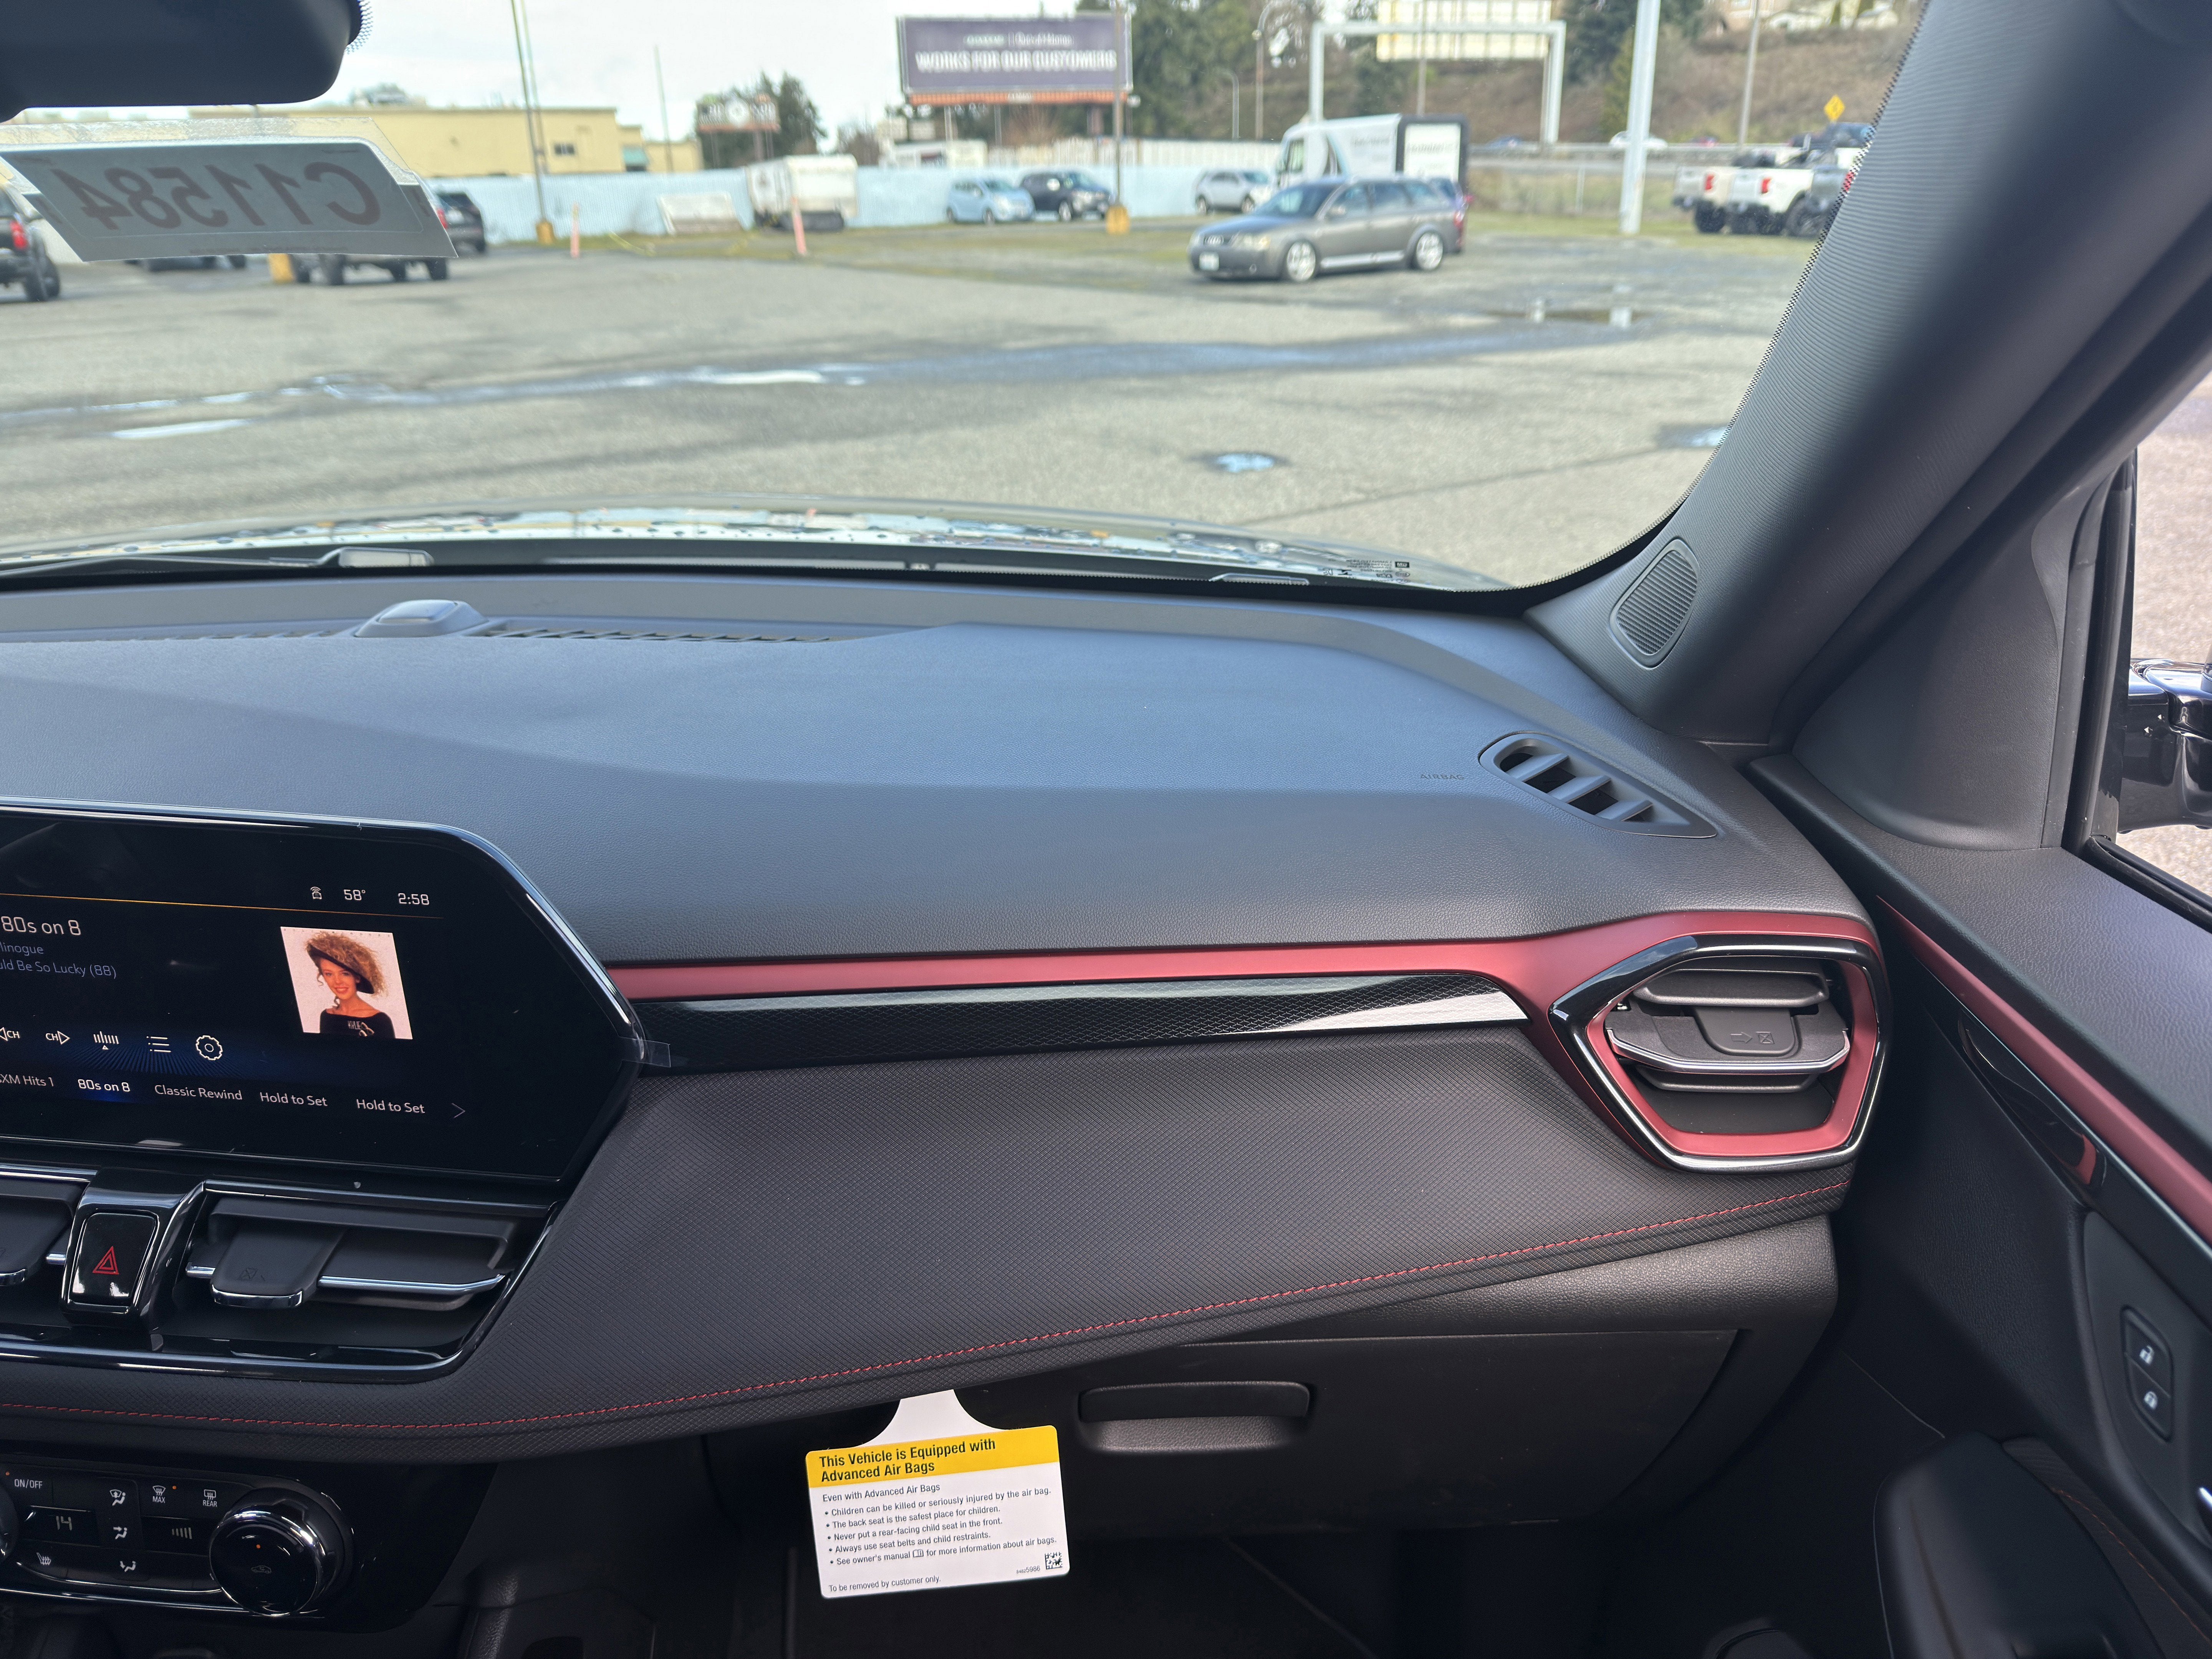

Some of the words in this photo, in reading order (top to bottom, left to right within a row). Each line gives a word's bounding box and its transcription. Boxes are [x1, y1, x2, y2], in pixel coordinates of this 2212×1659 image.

[344, 889, 365, 900] 58°
[398, 893, 429, 905] 2:58
[1, 916, 36, 932] 80s
[42, 923, 64, 934] on
[68, 920, 81, 935] 8
[0, 942, 43, 956] inogue
[17, 960, 32, 970] Be
[35, 962, 50, 972] So
[53, 963, 85, 977] Lucky
[90, 965, 116, 979] (88)
[23, 1076, 46, 1086] Hits
[48, 1078, 53, 1086] 1
[78, 1079, 101, 1089] 80s
[122, 1082, 130, 1091] 8
[155, 1085, 196, 1096] Classic
[199, 1088, 242, 1099] Rewind
[260, 1092, 288, 1103] Hold
[291, 1095, 304, 1104] to
[307, 1096, 327, 1106] Set
[357, 1099, 385, 1110] Hold
[389, 1103, 401, 1111] to
[404, 1103, 425, 1113] Set
[819, 1456, 845, 1467] This
[848, 1451, 892, 1464] Vehicle
[896, 1450, 906, 1460] is
[911, 1442, 965, 1458] Equipped
[970, 1440, 995, 1451] with
[821, 1467, 880, 1482] Advanced
[884, 1465, 901, 1476] Air
[905, 1462, 935, 1474] Bags
[15, 1479, 42, 1488] ON/OFF
[845, 1491, 862, 1500] with
[865, 1487, 904, 1498] Advanced
[907, 1485, 917, 1493] Air
[921, 1485, 940, 1493] Bags
[832, 1508, 864, 1516] Children
[895, 1501, 916, 1510] killed
[929, 1497, 963, 1506] seriously
[966, 1493, 993, 1503] injured
[909, 1512, 932, 1521] safest
[934, 1511, 954, 1520] place
[969, 1506, 1000, 1515] children.
[56, 1516, 72, 1530] 14
[858, 1531, 870, 1540] put
[879, 1527, 920, 1536] rear-facing
[922, 1523, 940, 1532] child
[942, 1522, 958, 1530] seat
[983, 1518, 1002, 1526] front.
[879, 1541, 895, 1549] seat
[934, 1535, 951, 1543] child
[954, 1532, 990, 1541] restraints.
[853, 1555, 881, 1563] owner's
[884, 1551, 910, 1560] manual
[960, 1543, 1000, 1553] information
[1003, 1540, 1023, 1548] about
[849, 1581, 879, 1590] removed
[892, 1578, 923, 1586] customer
